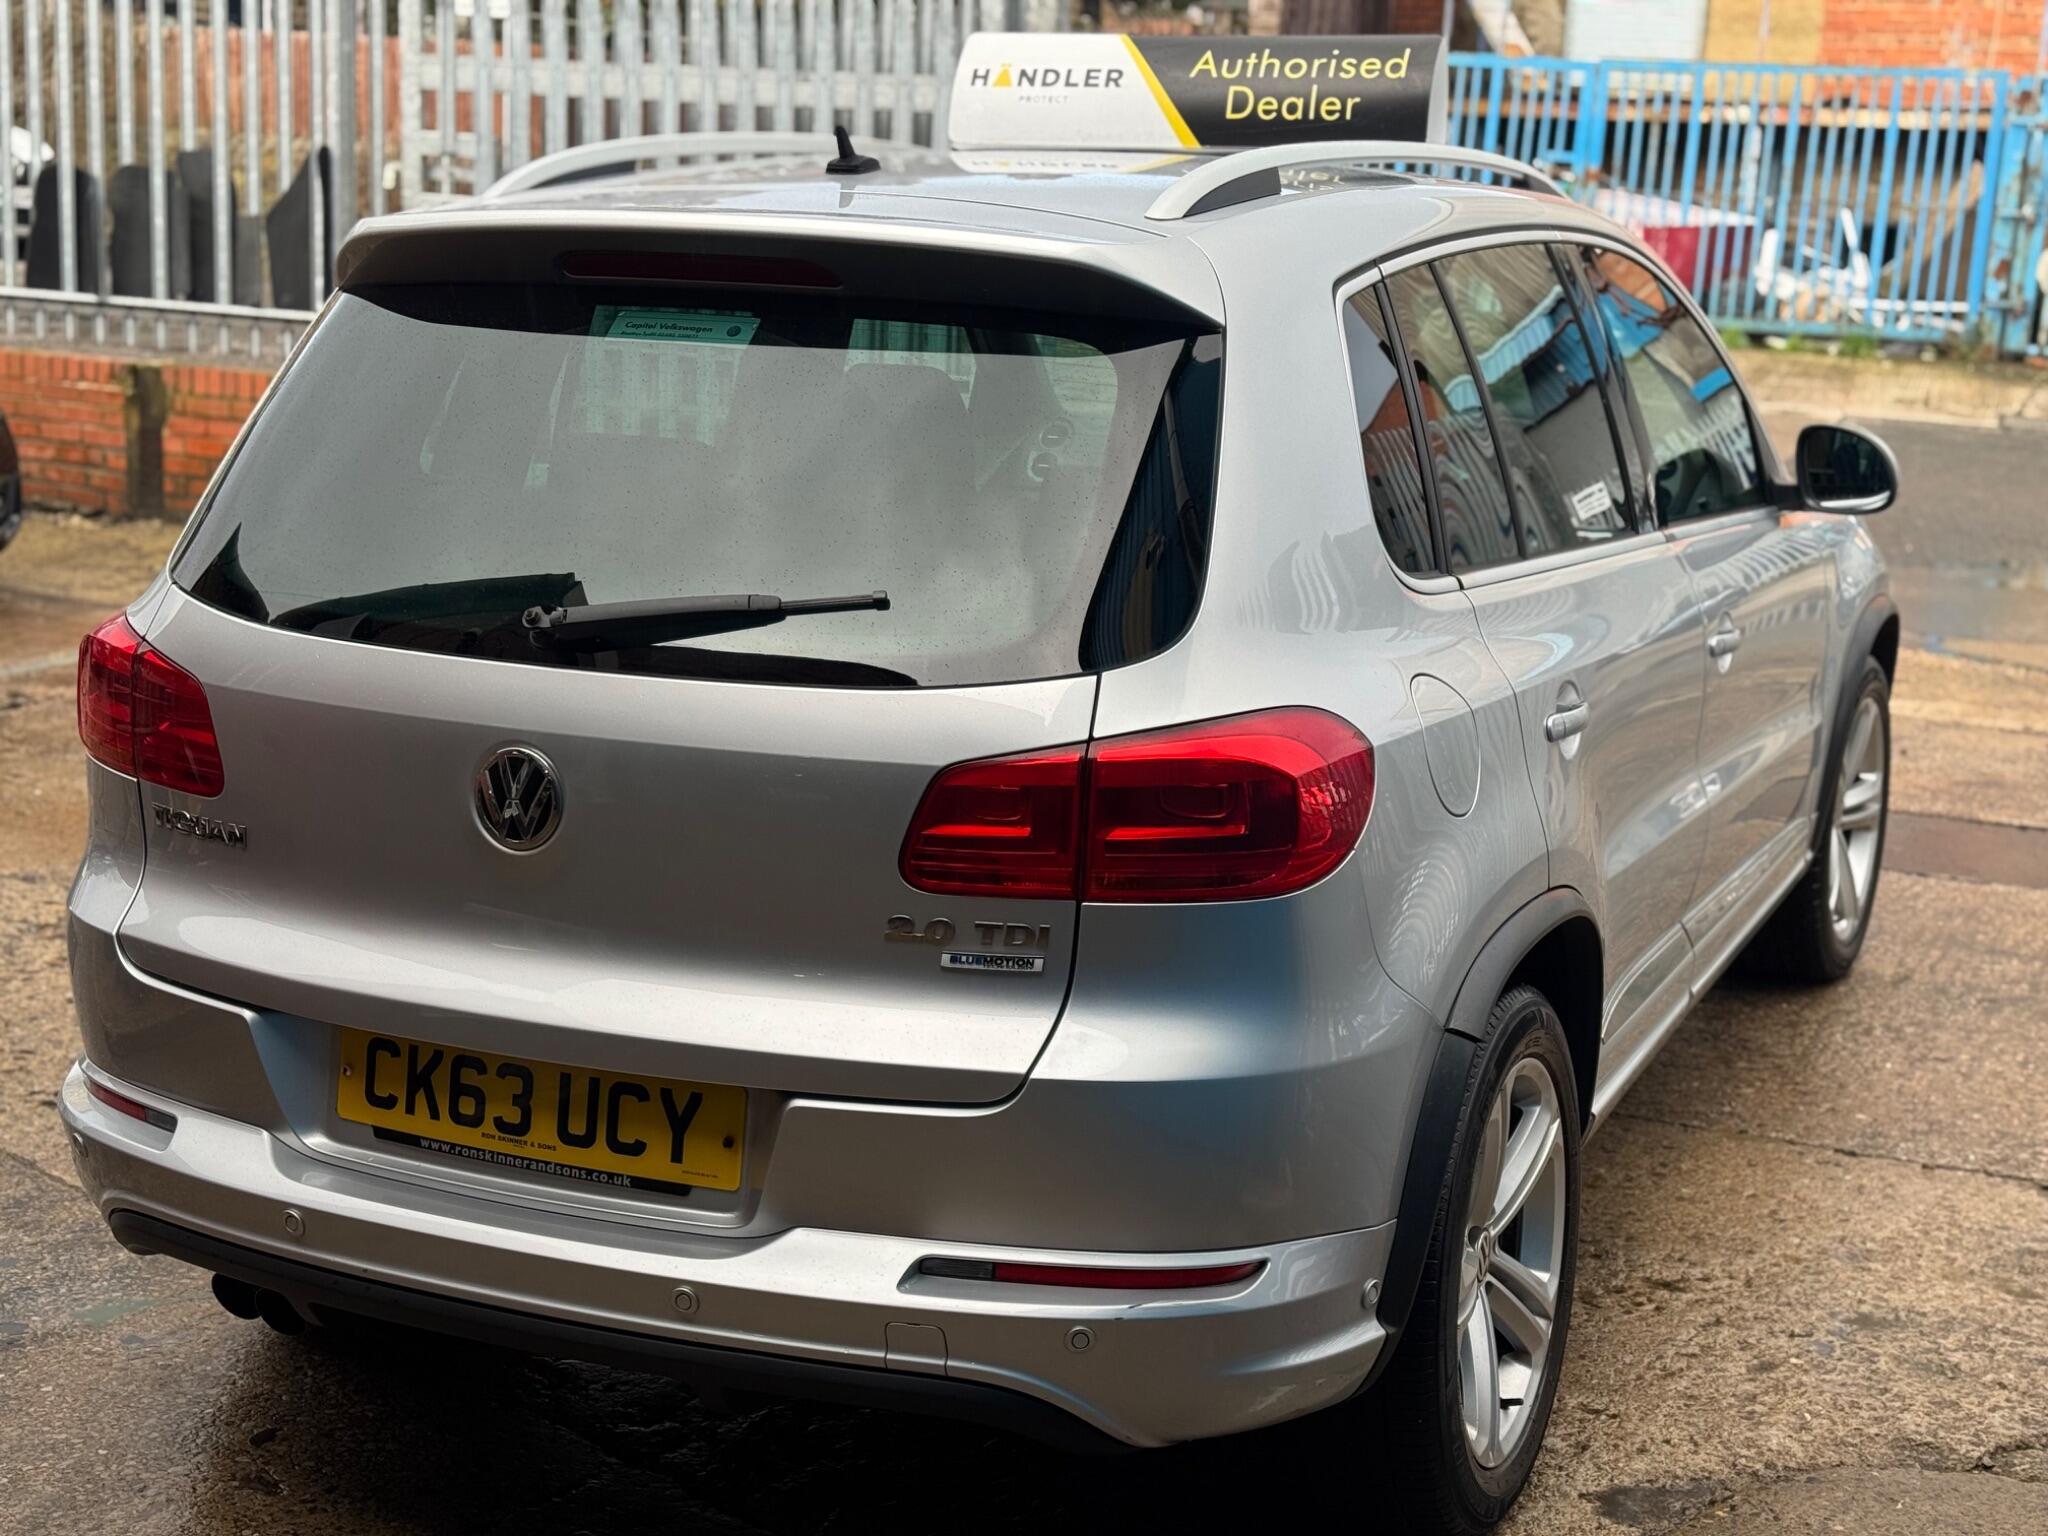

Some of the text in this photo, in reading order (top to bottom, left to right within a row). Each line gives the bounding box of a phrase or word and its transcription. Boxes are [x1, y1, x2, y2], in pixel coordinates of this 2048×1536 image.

[1189, 48, 1411, 79] Authorised
[1018, 95, 1069, 104] PROTECT
[1225, 85, 1361, 121] Dealer
[659, 322, 713, 333] Volkswagen
[151, 801, 248, 849] TIGUAN
[884, 914, 1051, 947] 2.0 TDI
[949, 954, 1036, 969] BLUEMOTION
[364, 1036, 704, 1165] CK63 UCY
[481, 1131, 496, 1140] RON
[497, 1134, 528, 1147] SKINNER
[537, 1142, 557, 1151] SONS
[420, 1138, 631, 1187] www.ronskinnerandsons.co.uk
